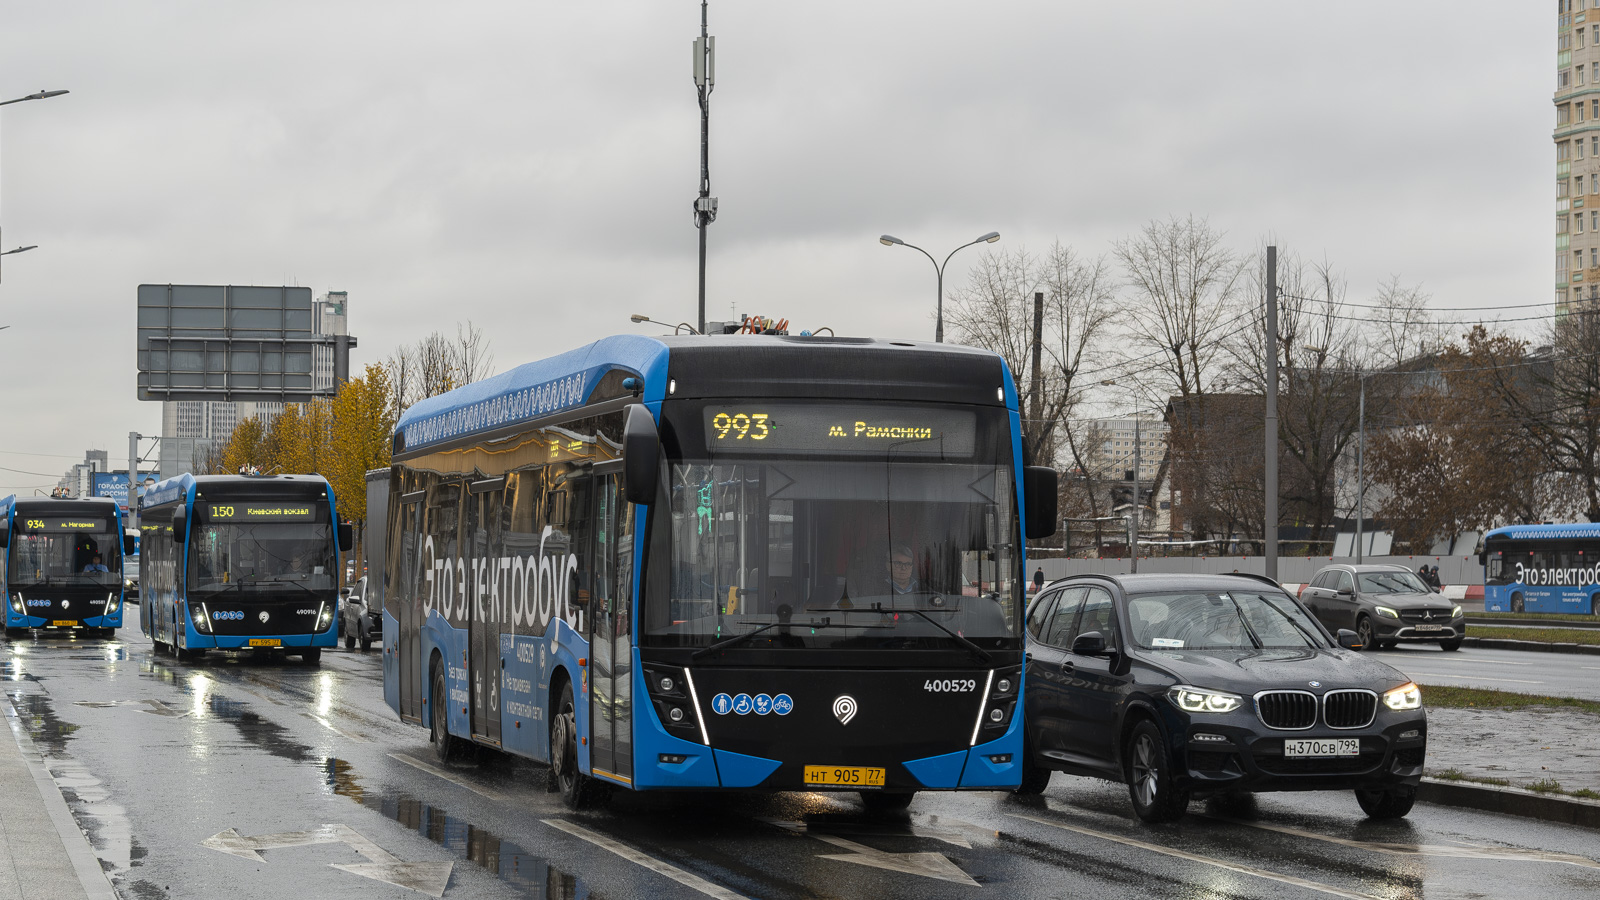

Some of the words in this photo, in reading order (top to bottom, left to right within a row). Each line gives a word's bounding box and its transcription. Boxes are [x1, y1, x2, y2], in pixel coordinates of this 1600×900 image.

[713, 413, 768, 440] 993
[829, 425, 847, 437] м.
[854, 421, 931, 438] Рамонки
[212, 506, 234, 517] 150
[247, 507, 281, 515] Киевский
[27, 520, 45, 528] 934
[423, 535, 453, 620] Это
[1515, 562, 1538, 585] Это
[517, 642, 534, 663] 400529
[924, 678, 976, 693] 400529
[1338, 740, 1356, 750] 799
[834, 769, 860, 783] 905
[868, 769, 880, 779] 77
